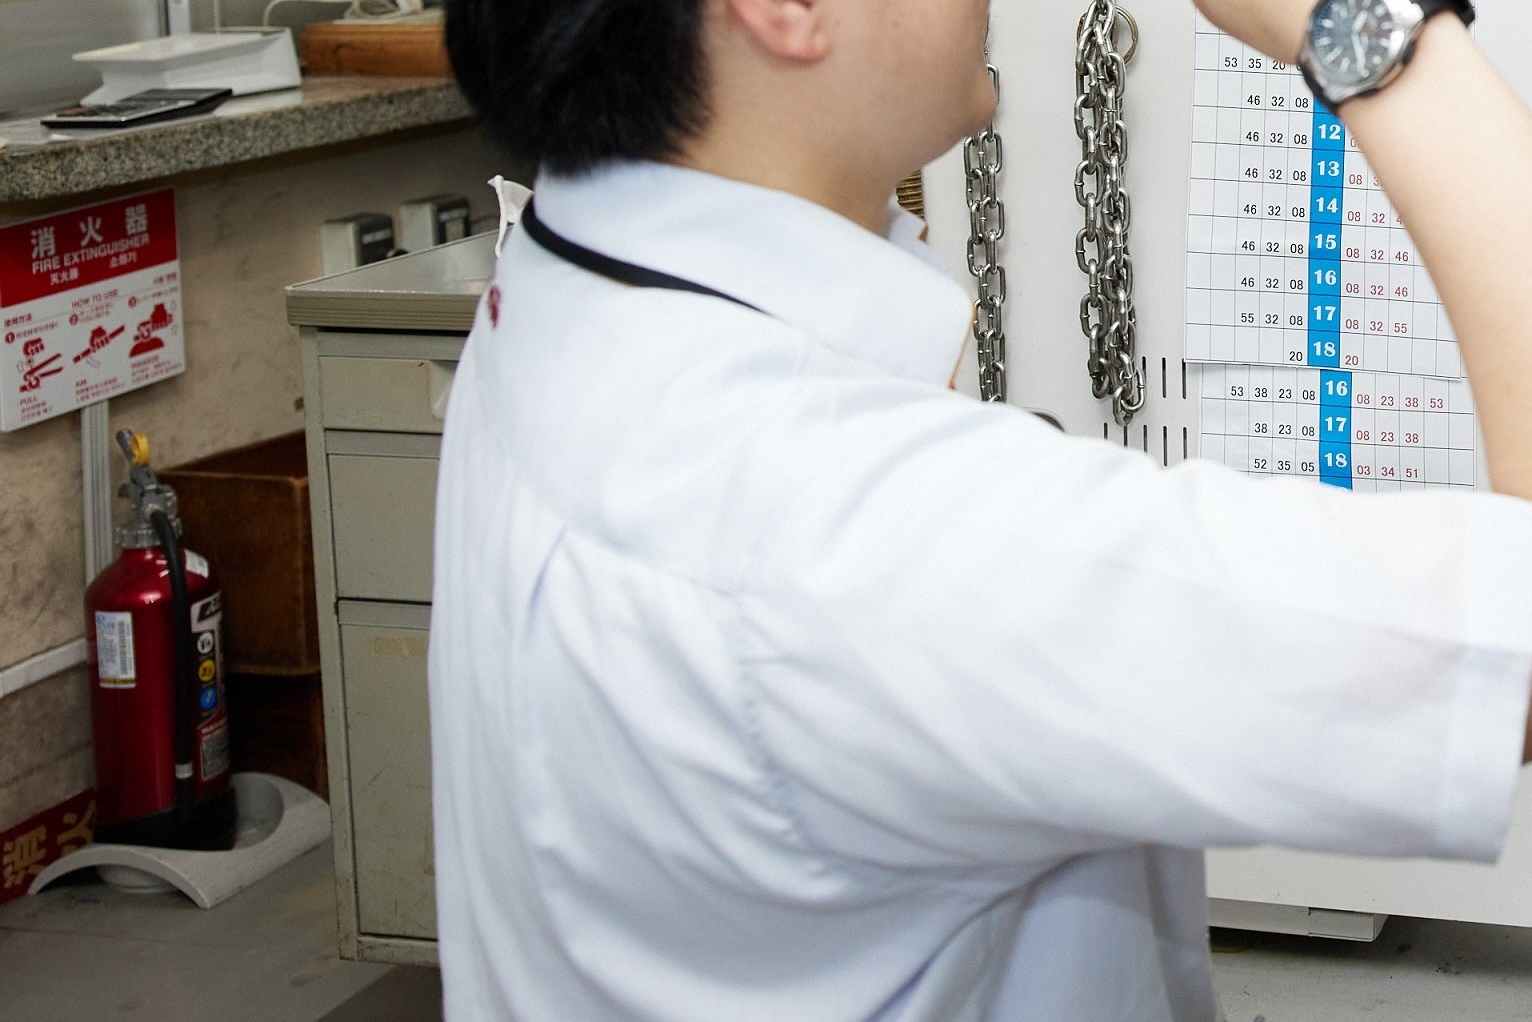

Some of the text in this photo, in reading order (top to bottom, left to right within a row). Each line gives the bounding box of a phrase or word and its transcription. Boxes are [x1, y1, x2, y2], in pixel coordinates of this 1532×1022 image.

[1224, 56, 1238, 68] 53
[1248, 58, 1262, 70] 35
[1272, 59, 1286, 70] 20
[1246, 94, 1309, 109] 46 32 08
[1245, 131, 1260, 143] 46
[1269, 132, 1284, 144] 32
[1293, 133, 1308, 146] 08
[1317, 124, 1341, 140] 12
[1244, 167, 1259, 179] 46
[1268, 168, 1283, 181] 32
[1292, 170, 1307, 182] 08
[1317, 160, 1340, 177] 13
[1348, 174, 1363, 186] 08
[1243, 203, 1257, 215] 46
[1267, 205, 1281, 217] 32
[1291, 206, 1306, 218] 08
[1316, 197, 1338, 213] 14
[1347, 210, 1361, 222] 08
[1371, 212, 1386, 224] 32
[30, 203, 149, 260] 消火器
[31, 233, 150, 276] FIRE EXTINGUISHER
[1241, 233, 1409, 262] 46 32 08 15 08 32 46
[1240, 269, 1409, 298] 46 32 08 16 08 32 46
[71, 295, 91, 309] HOW
[91, 292, 103, 303] TO
[1240, 305, 1408, 334] 55 32 08 17 08 32 55
[1288, 341, 1359, 366] 20 18 20
[19, 394, 39, 406] PULL
[1230, 380, 1444, 409] 53 38 23 08 16 08 23 38 53
[1254, 416, 1419, 444] 38 23 08 17 08 23 38
[1253, 452, 1418, 479] 52 35 05 18 03 34 51
